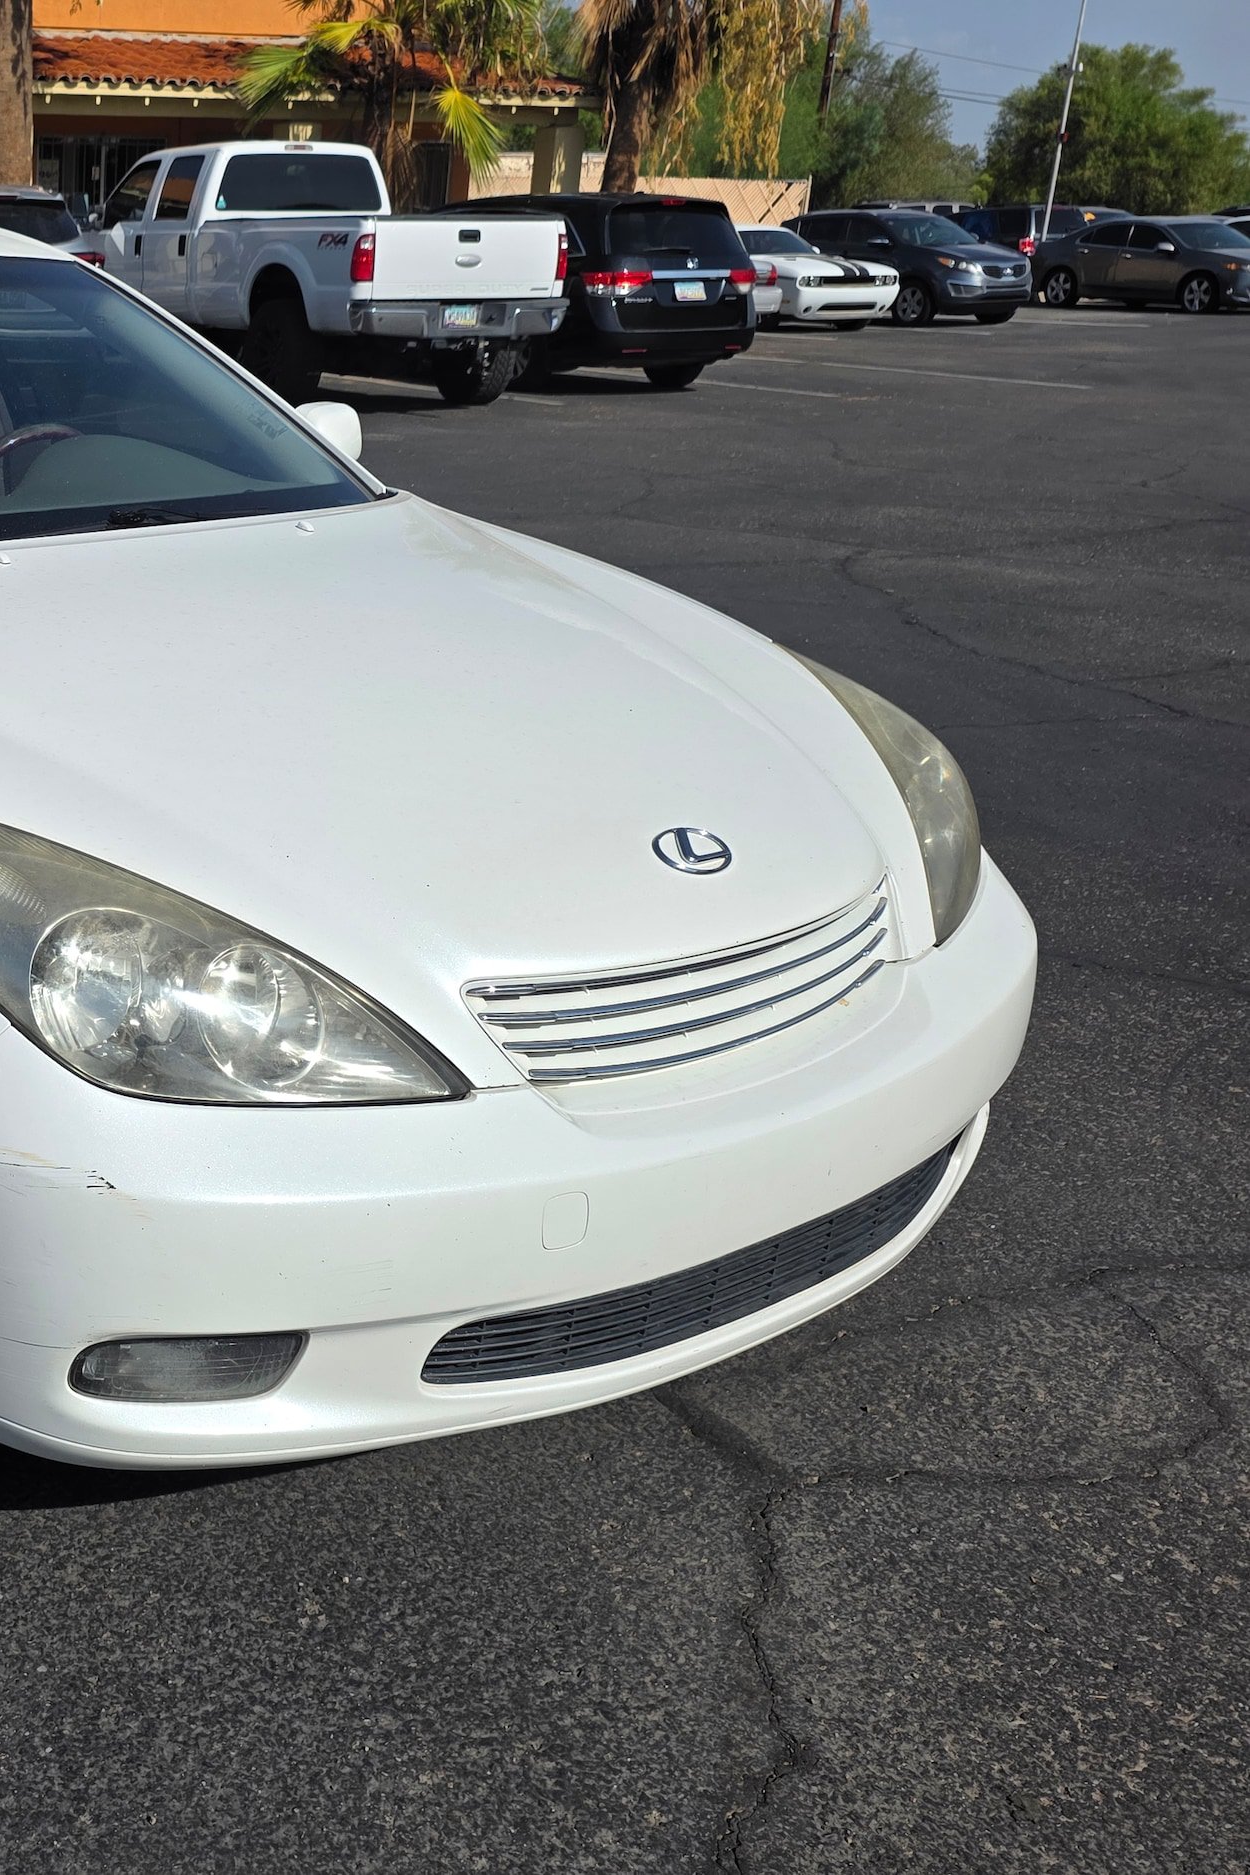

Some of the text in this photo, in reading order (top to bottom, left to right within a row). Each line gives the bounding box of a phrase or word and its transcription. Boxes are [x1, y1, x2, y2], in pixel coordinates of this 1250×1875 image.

[318, 233, 349, 247] FX4
[406, 284, 465, 294] SUPER
[478, 283, 524, 293] DUTY
